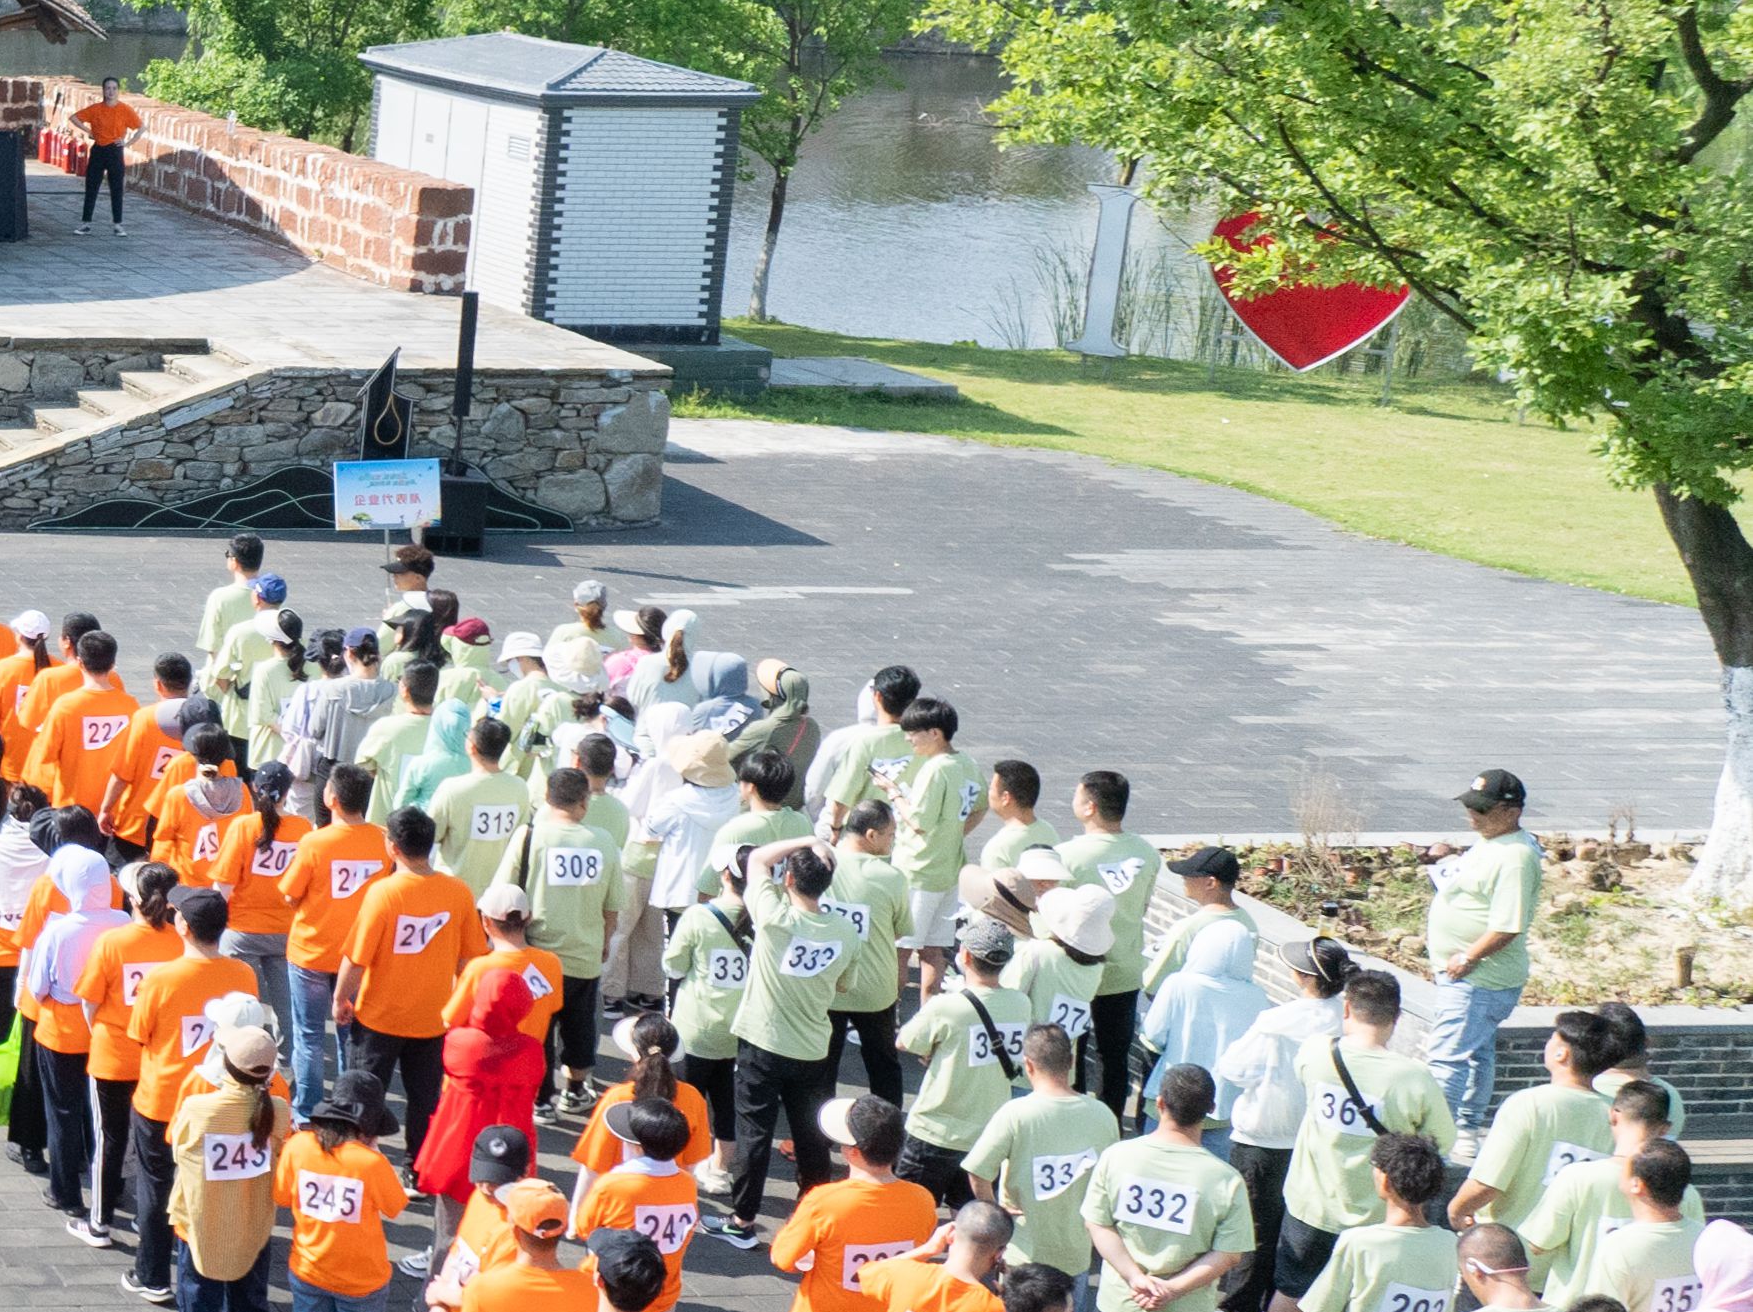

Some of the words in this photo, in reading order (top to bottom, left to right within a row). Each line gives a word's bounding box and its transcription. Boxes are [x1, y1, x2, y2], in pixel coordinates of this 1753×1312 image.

[88, 721, 124, 744] 22
[478, 811, 515, 835] 313
[555, 855, 598, 879] 308
[715, 956, 750, 982] 33
[1040, 1157, 1088, 1192] 33
[305, 1181, 355, 1216] 245
[1126, 1184, 1188, 1225] 332
